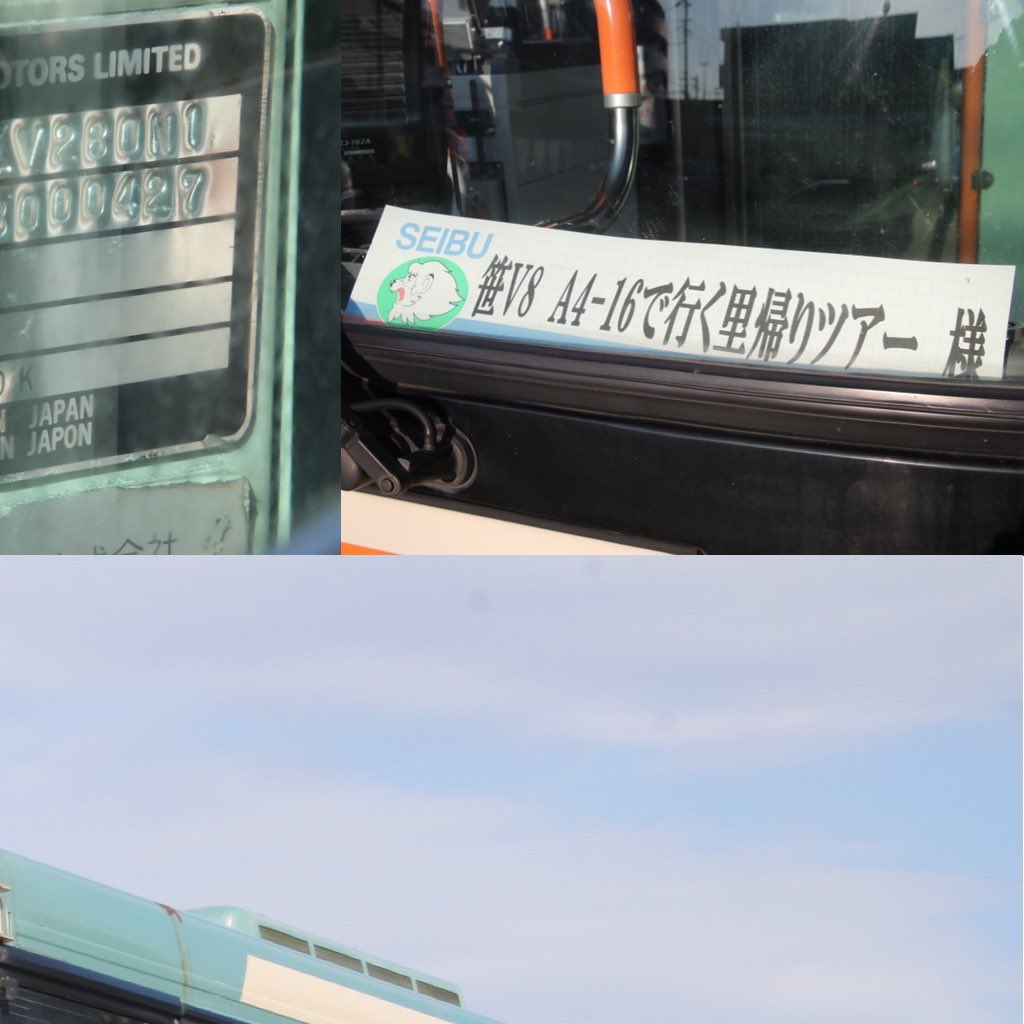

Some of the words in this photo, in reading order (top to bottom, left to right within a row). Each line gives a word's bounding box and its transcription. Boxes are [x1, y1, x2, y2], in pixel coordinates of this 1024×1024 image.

[93, 42, 202, 79] LIMITED
[394, 222, 494, 260] SEIBU
[470, 253, 543, 319] 笹V8
[546, 268, 919, 371] A4-16で行く里帰りツアー
[941, 307, 988, 380] 様
[28, 394, 94, 429] JAPAN
[26, 421, 93, 457] JAPON
